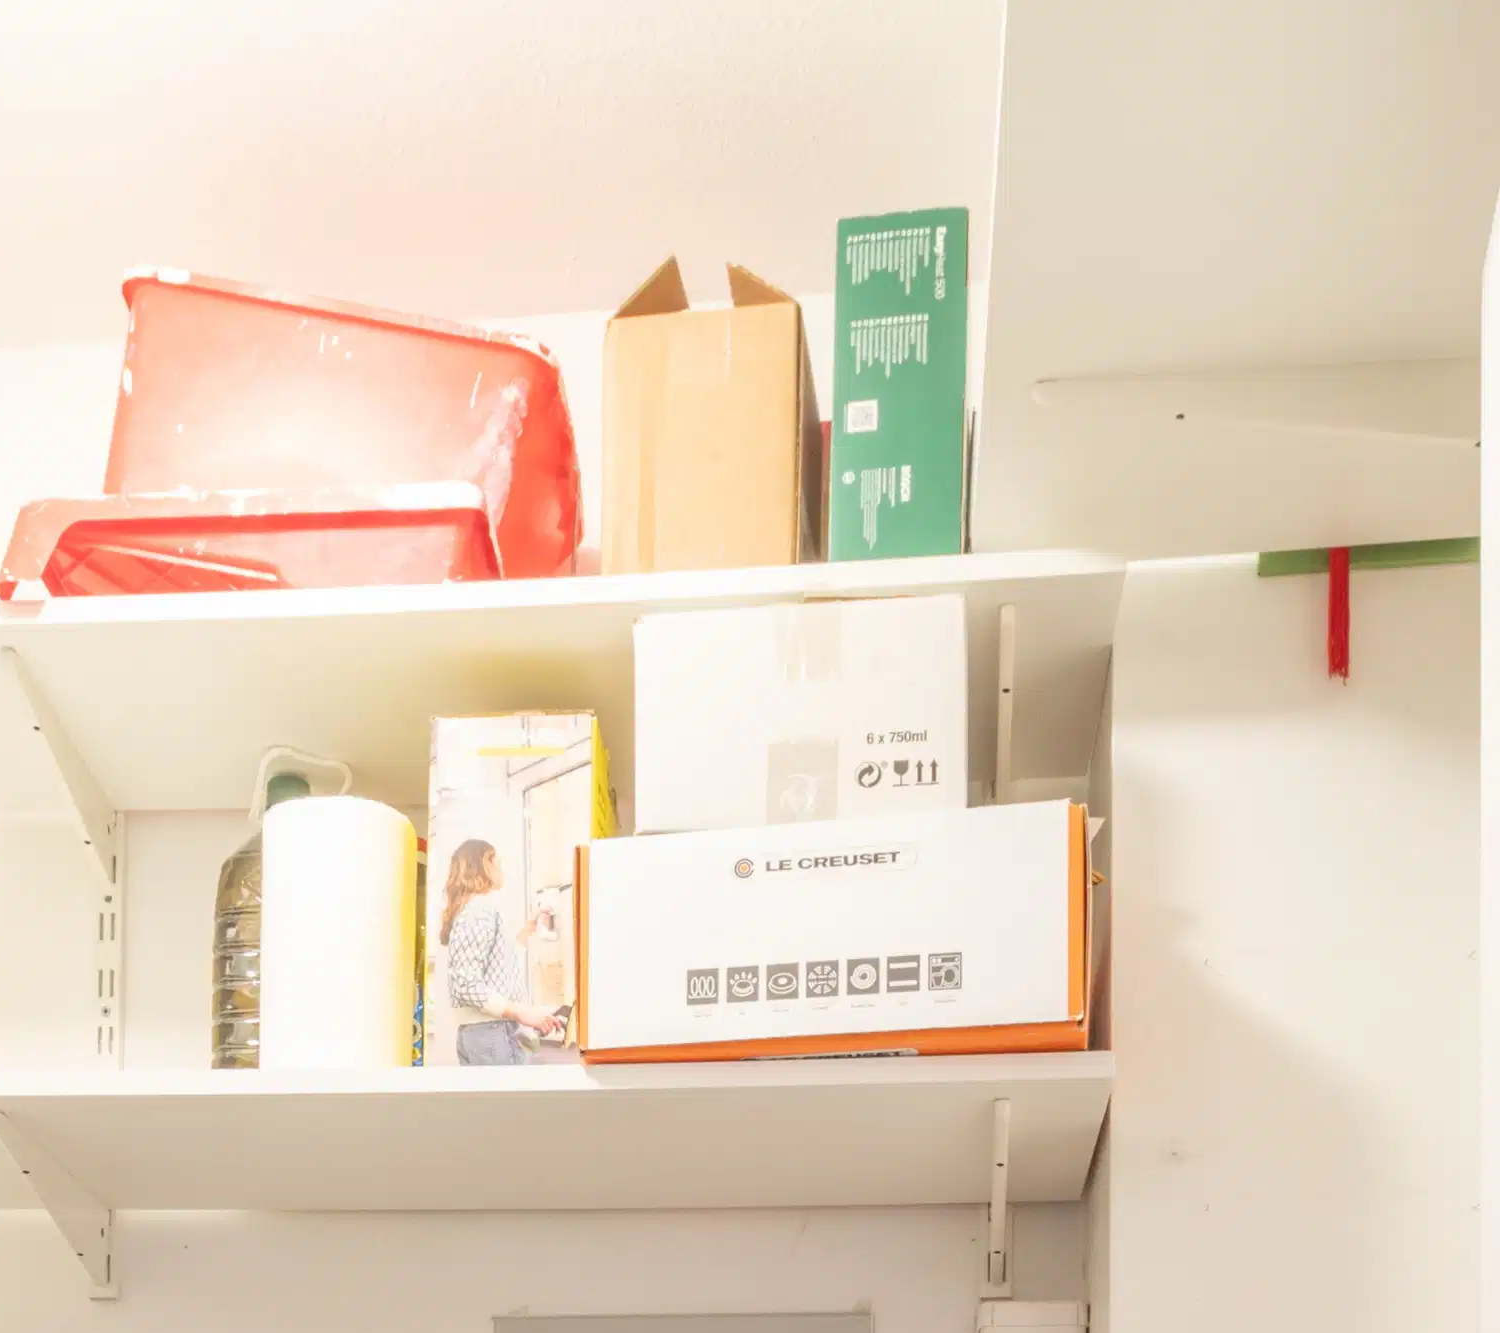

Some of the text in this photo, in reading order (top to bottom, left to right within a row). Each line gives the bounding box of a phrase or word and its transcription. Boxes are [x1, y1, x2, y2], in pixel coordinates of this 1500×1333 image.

[866, 729, 928, 744] 6 x 750ml
[765, 851, 901, 872] LE CREUSET
